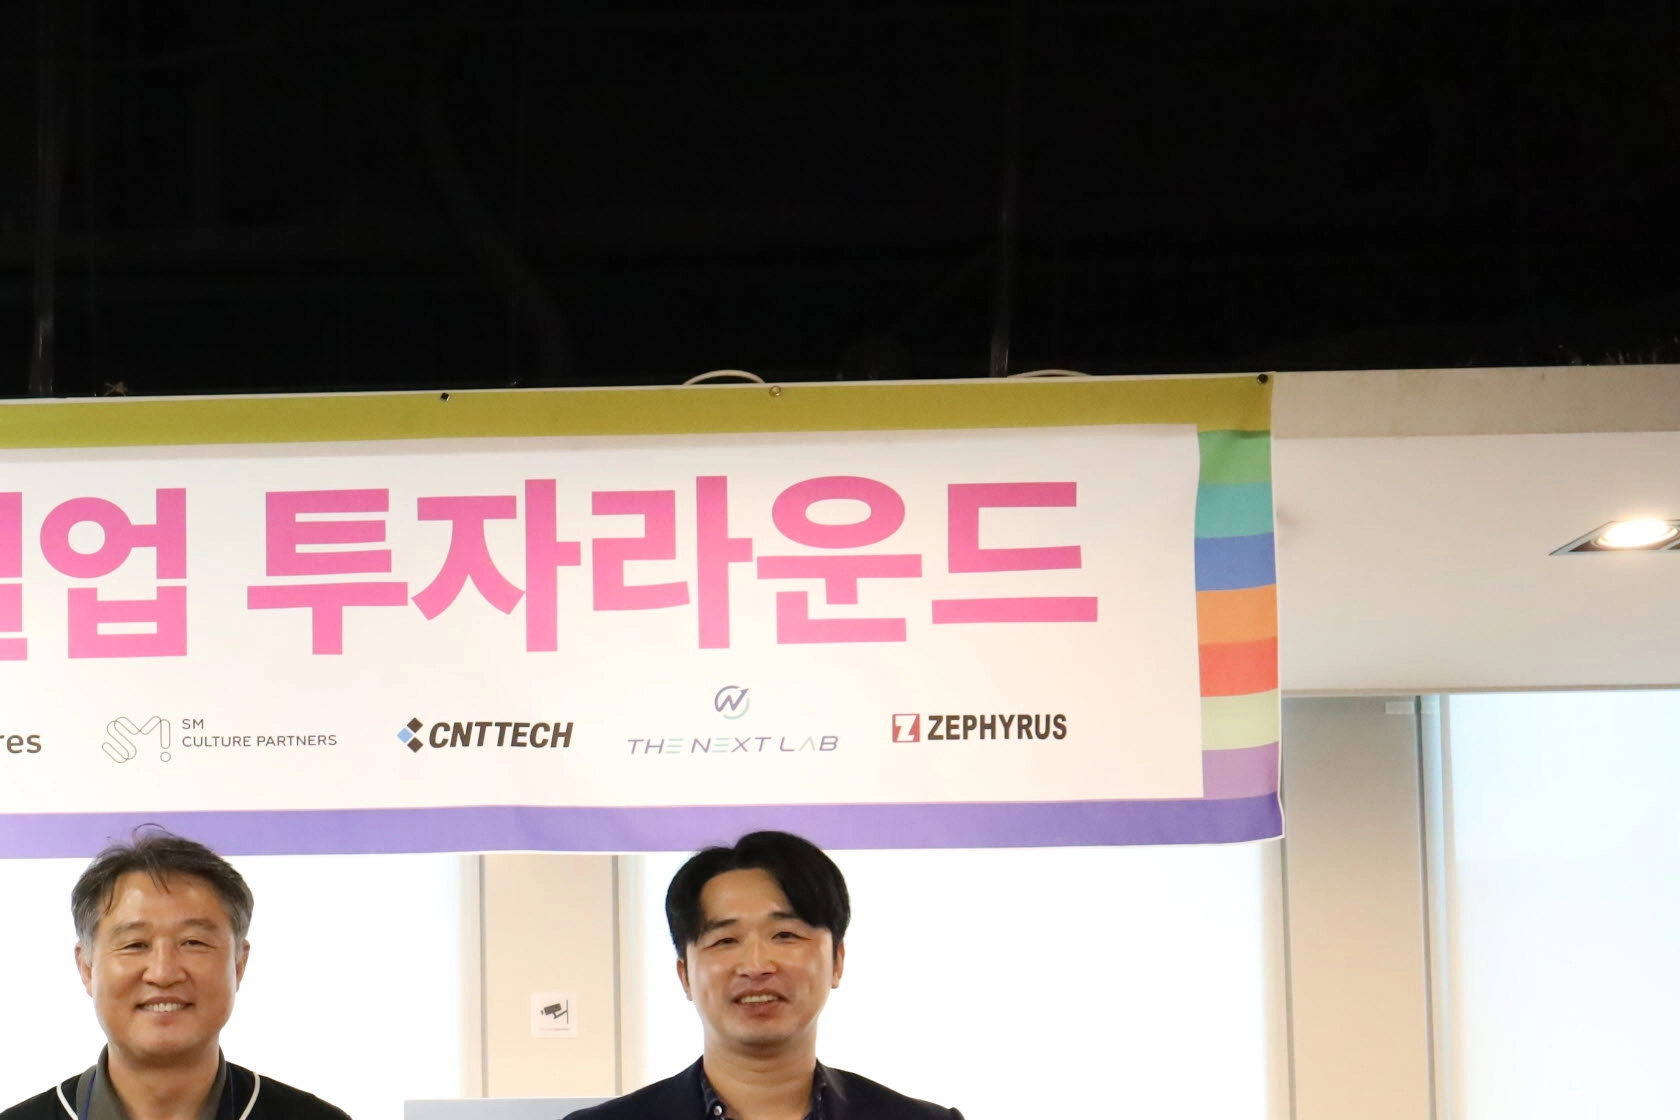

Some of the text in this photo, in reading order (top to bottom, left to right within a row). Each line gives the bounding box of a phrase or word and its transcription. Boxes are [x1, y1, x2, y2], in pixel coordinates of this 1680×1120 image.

[246, 475, 1098, 655] 투자라운드
[181, 718, 205, 730] SM
[428, 721, 574, 748] CNTTECH
[927, 713, 1068, 740] ZEPHYRUS
[181, 734, 338, 747] CULTURE PARTNERS
[627, 735, 839, 755] THE NEXT LAB
